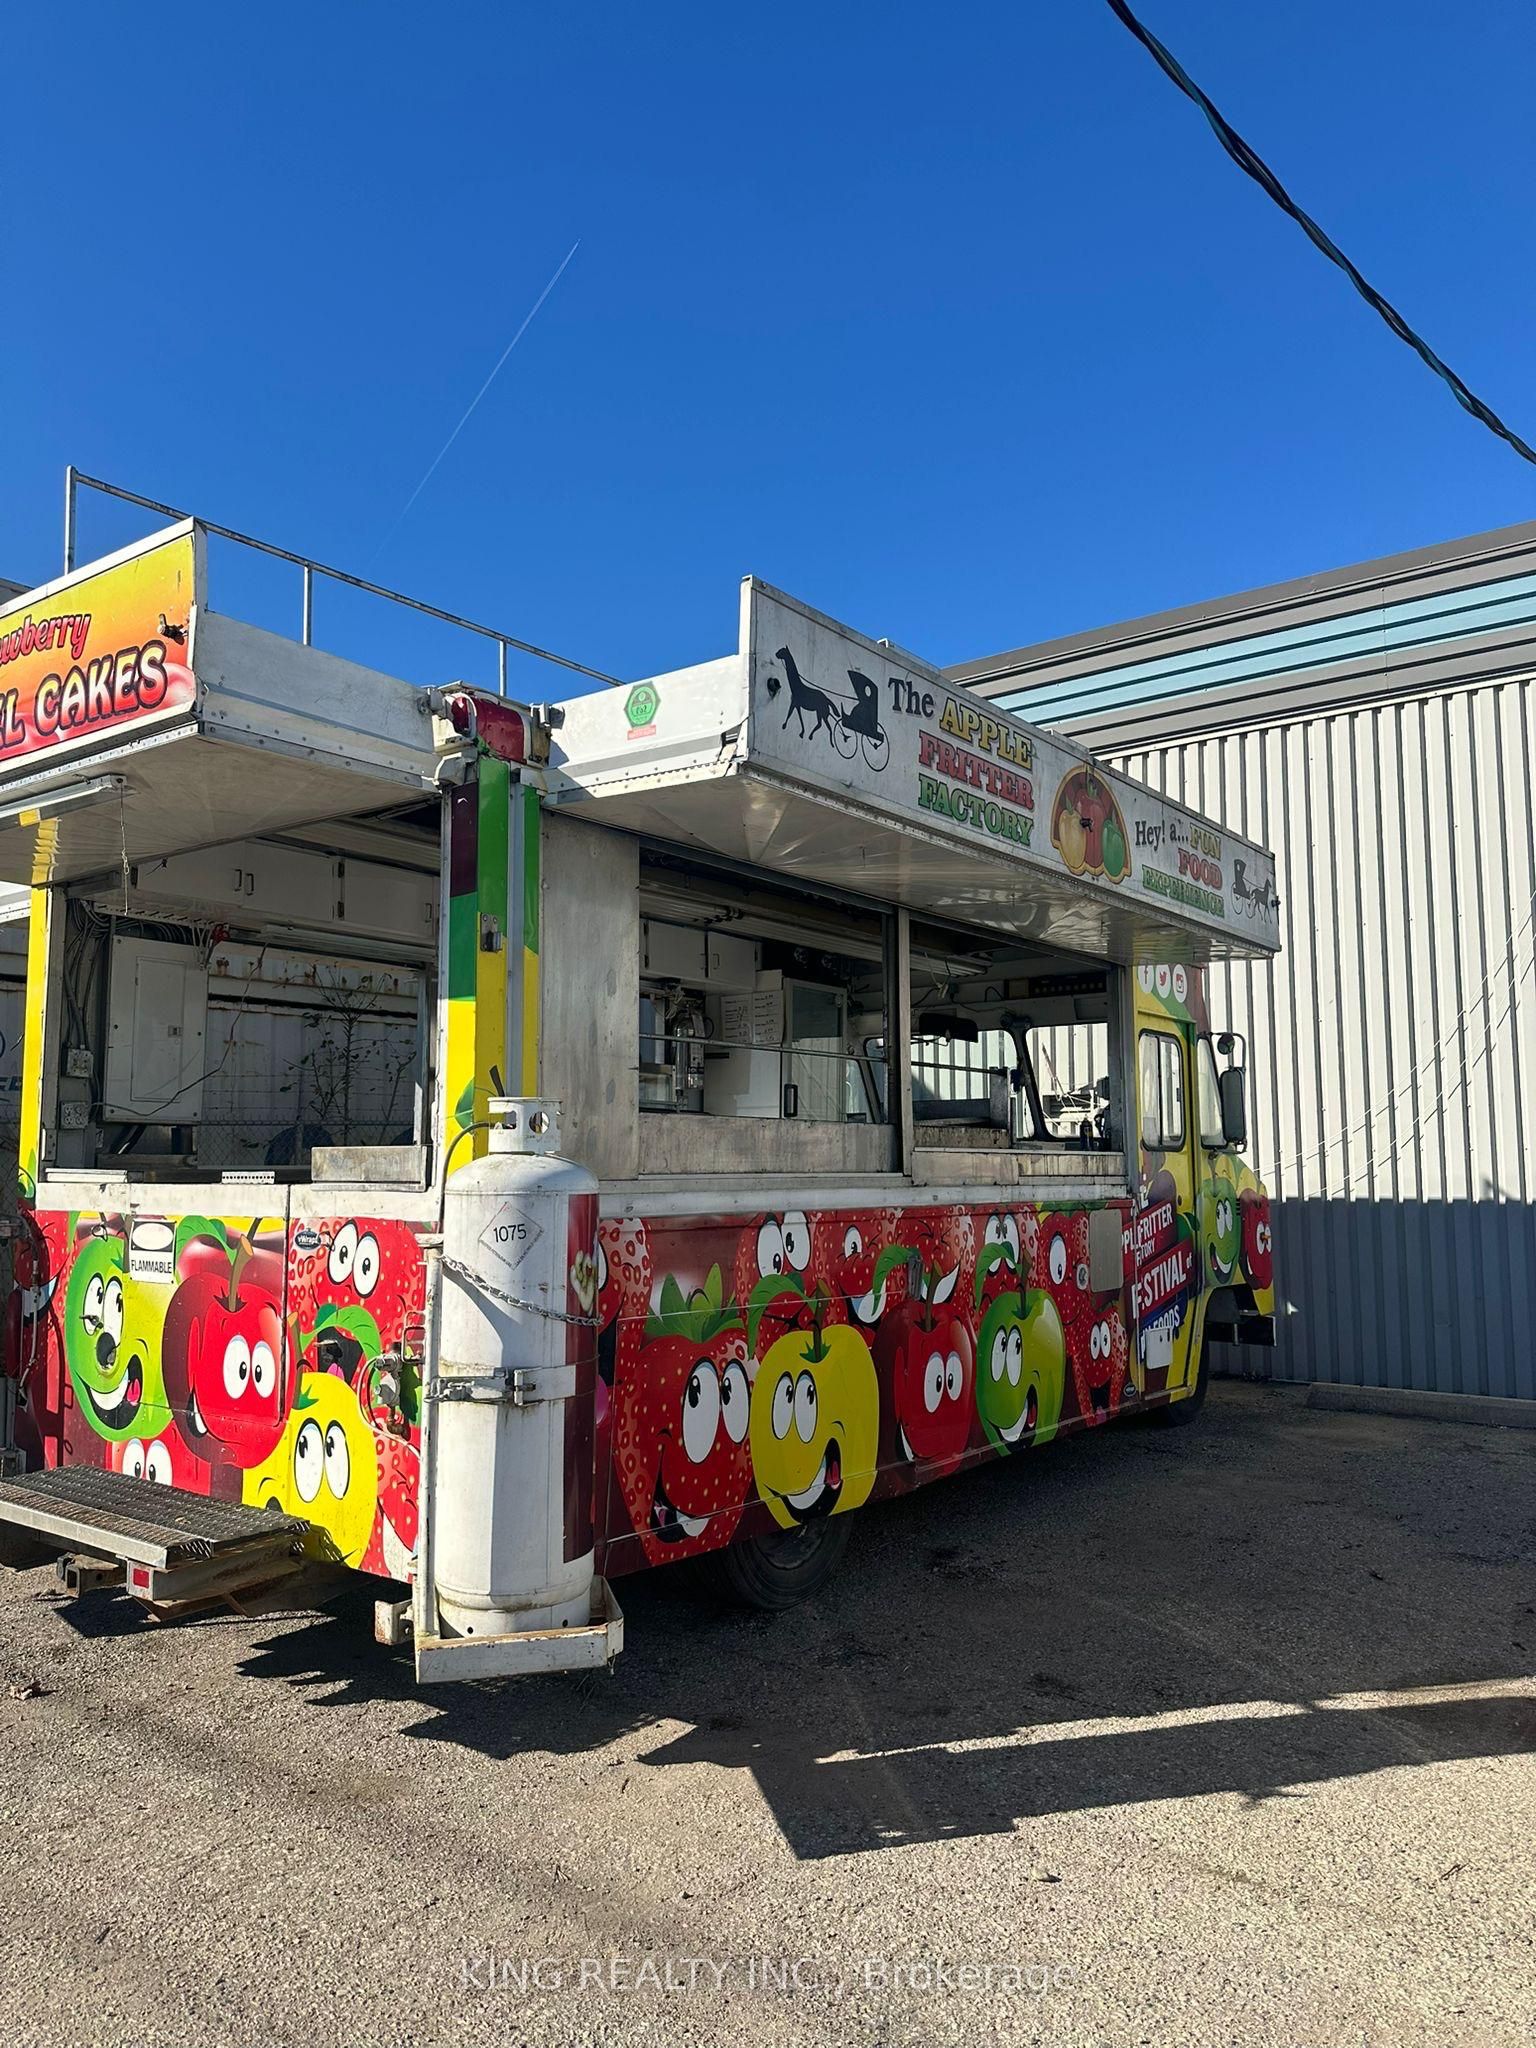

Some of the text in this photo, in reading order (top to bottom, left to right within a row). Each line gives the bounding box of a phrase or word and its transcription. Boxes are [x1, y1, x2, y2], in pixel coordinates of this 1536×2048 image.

[0, 613, 91, 666] wberry
[34, 639, 168, 736] CAKES
[888, 677, 1033, 771] The APPLE
[919, 729, 1034, 810] FRITTER
[918, 772, 1034, 846] FACTORY
[1135, 819, 1165, 851] Hey!
[1190, 822, 1221, 861] FUN
[1142, 864, 1224, 918] EXPERIENCE
[1178, 848, 1223, 890] FOOD
[493, 1223, 527, 1243] 1075
[131, 1259, 172, 1274] FLAMMABLE
[1131, 1251, 1186, 1319] FSTIVAL
